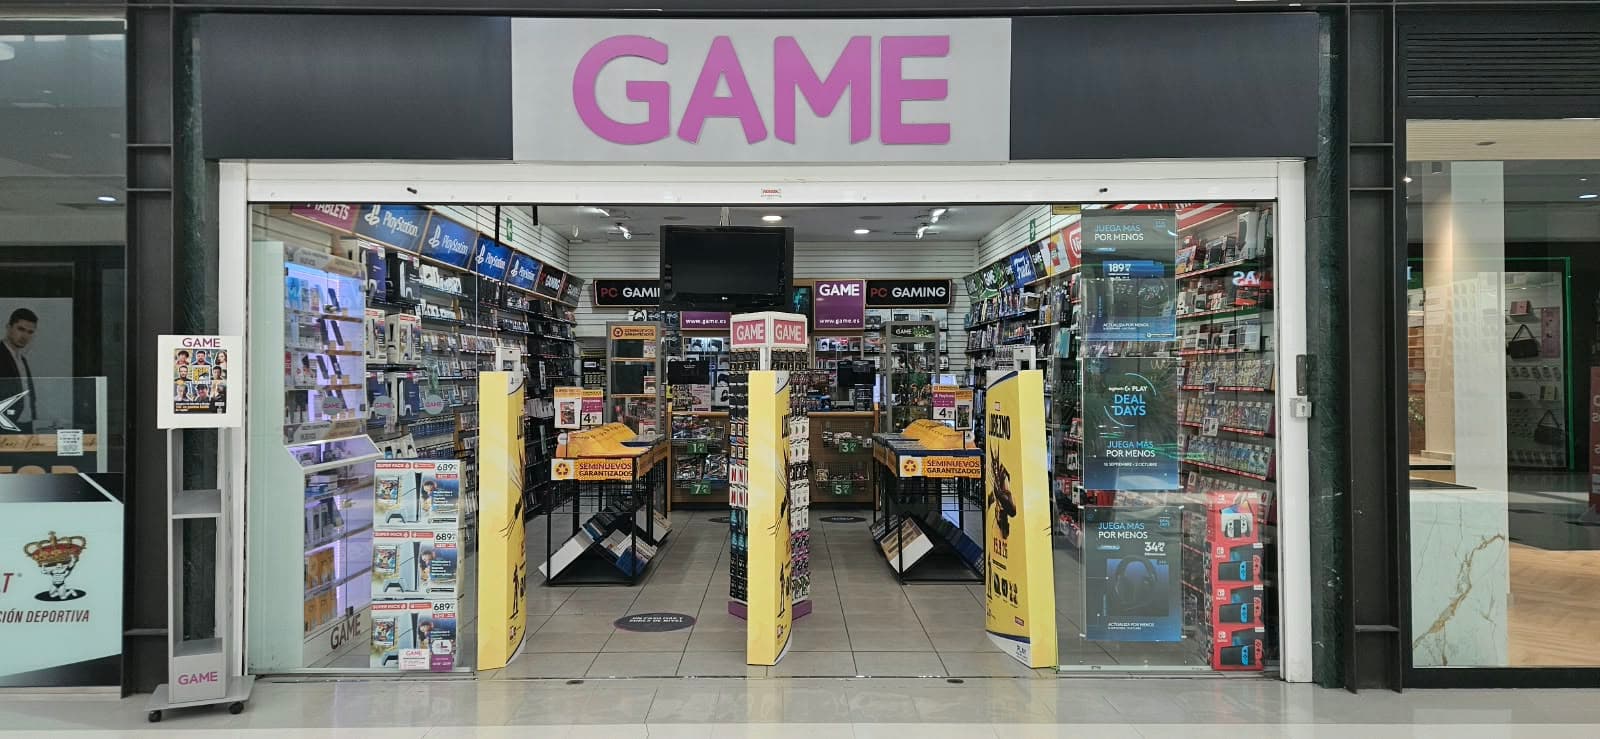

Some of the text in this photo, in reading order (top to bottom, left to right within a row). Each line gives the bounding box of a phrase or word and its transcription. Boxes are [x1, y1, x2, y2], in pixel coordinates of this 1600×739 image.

[572, 34, 951, 145] GAME
[382, 211, 418, 237] PlayStation
[1095, 224, 1121, 232] JUEGA
[1094, 233, 1144, 241] POR MENOS
[441, 233, 469, 255] PlayStation
[485, 252, 506, 270] PlayStation
[518, 266, 536, 281] PlayStation
[600, 287, 660, 298] PC GAMI
[819, 283, 860, 297] GAME
[870, 286, 947, 298] PC GAMING
[736, 323, 764, 341] GAME
[775, 324, 802, 342] GAME
[182, 337, 221, 348] GAME
[1114, 394, 1146, 404] DEAL
[1114, 405, 1147, 416] DAYS
[1107, 440, 1134, 449] JUEGA
[1106, 449, 1156, 458] POR MENOS
[927, 460, 980, 468] SEMINUEVOS
[926, 467, 981, 475] GARANTIZADOS
[1098, 522, 1125, 530] JUEGA
[1098, 531, 1148, 539] POR MENOS
[25, 609, 90, 623] DEPORTIVA
[330, 613, 361, 650] GAME
[177, 671, 218, 686] GAME
